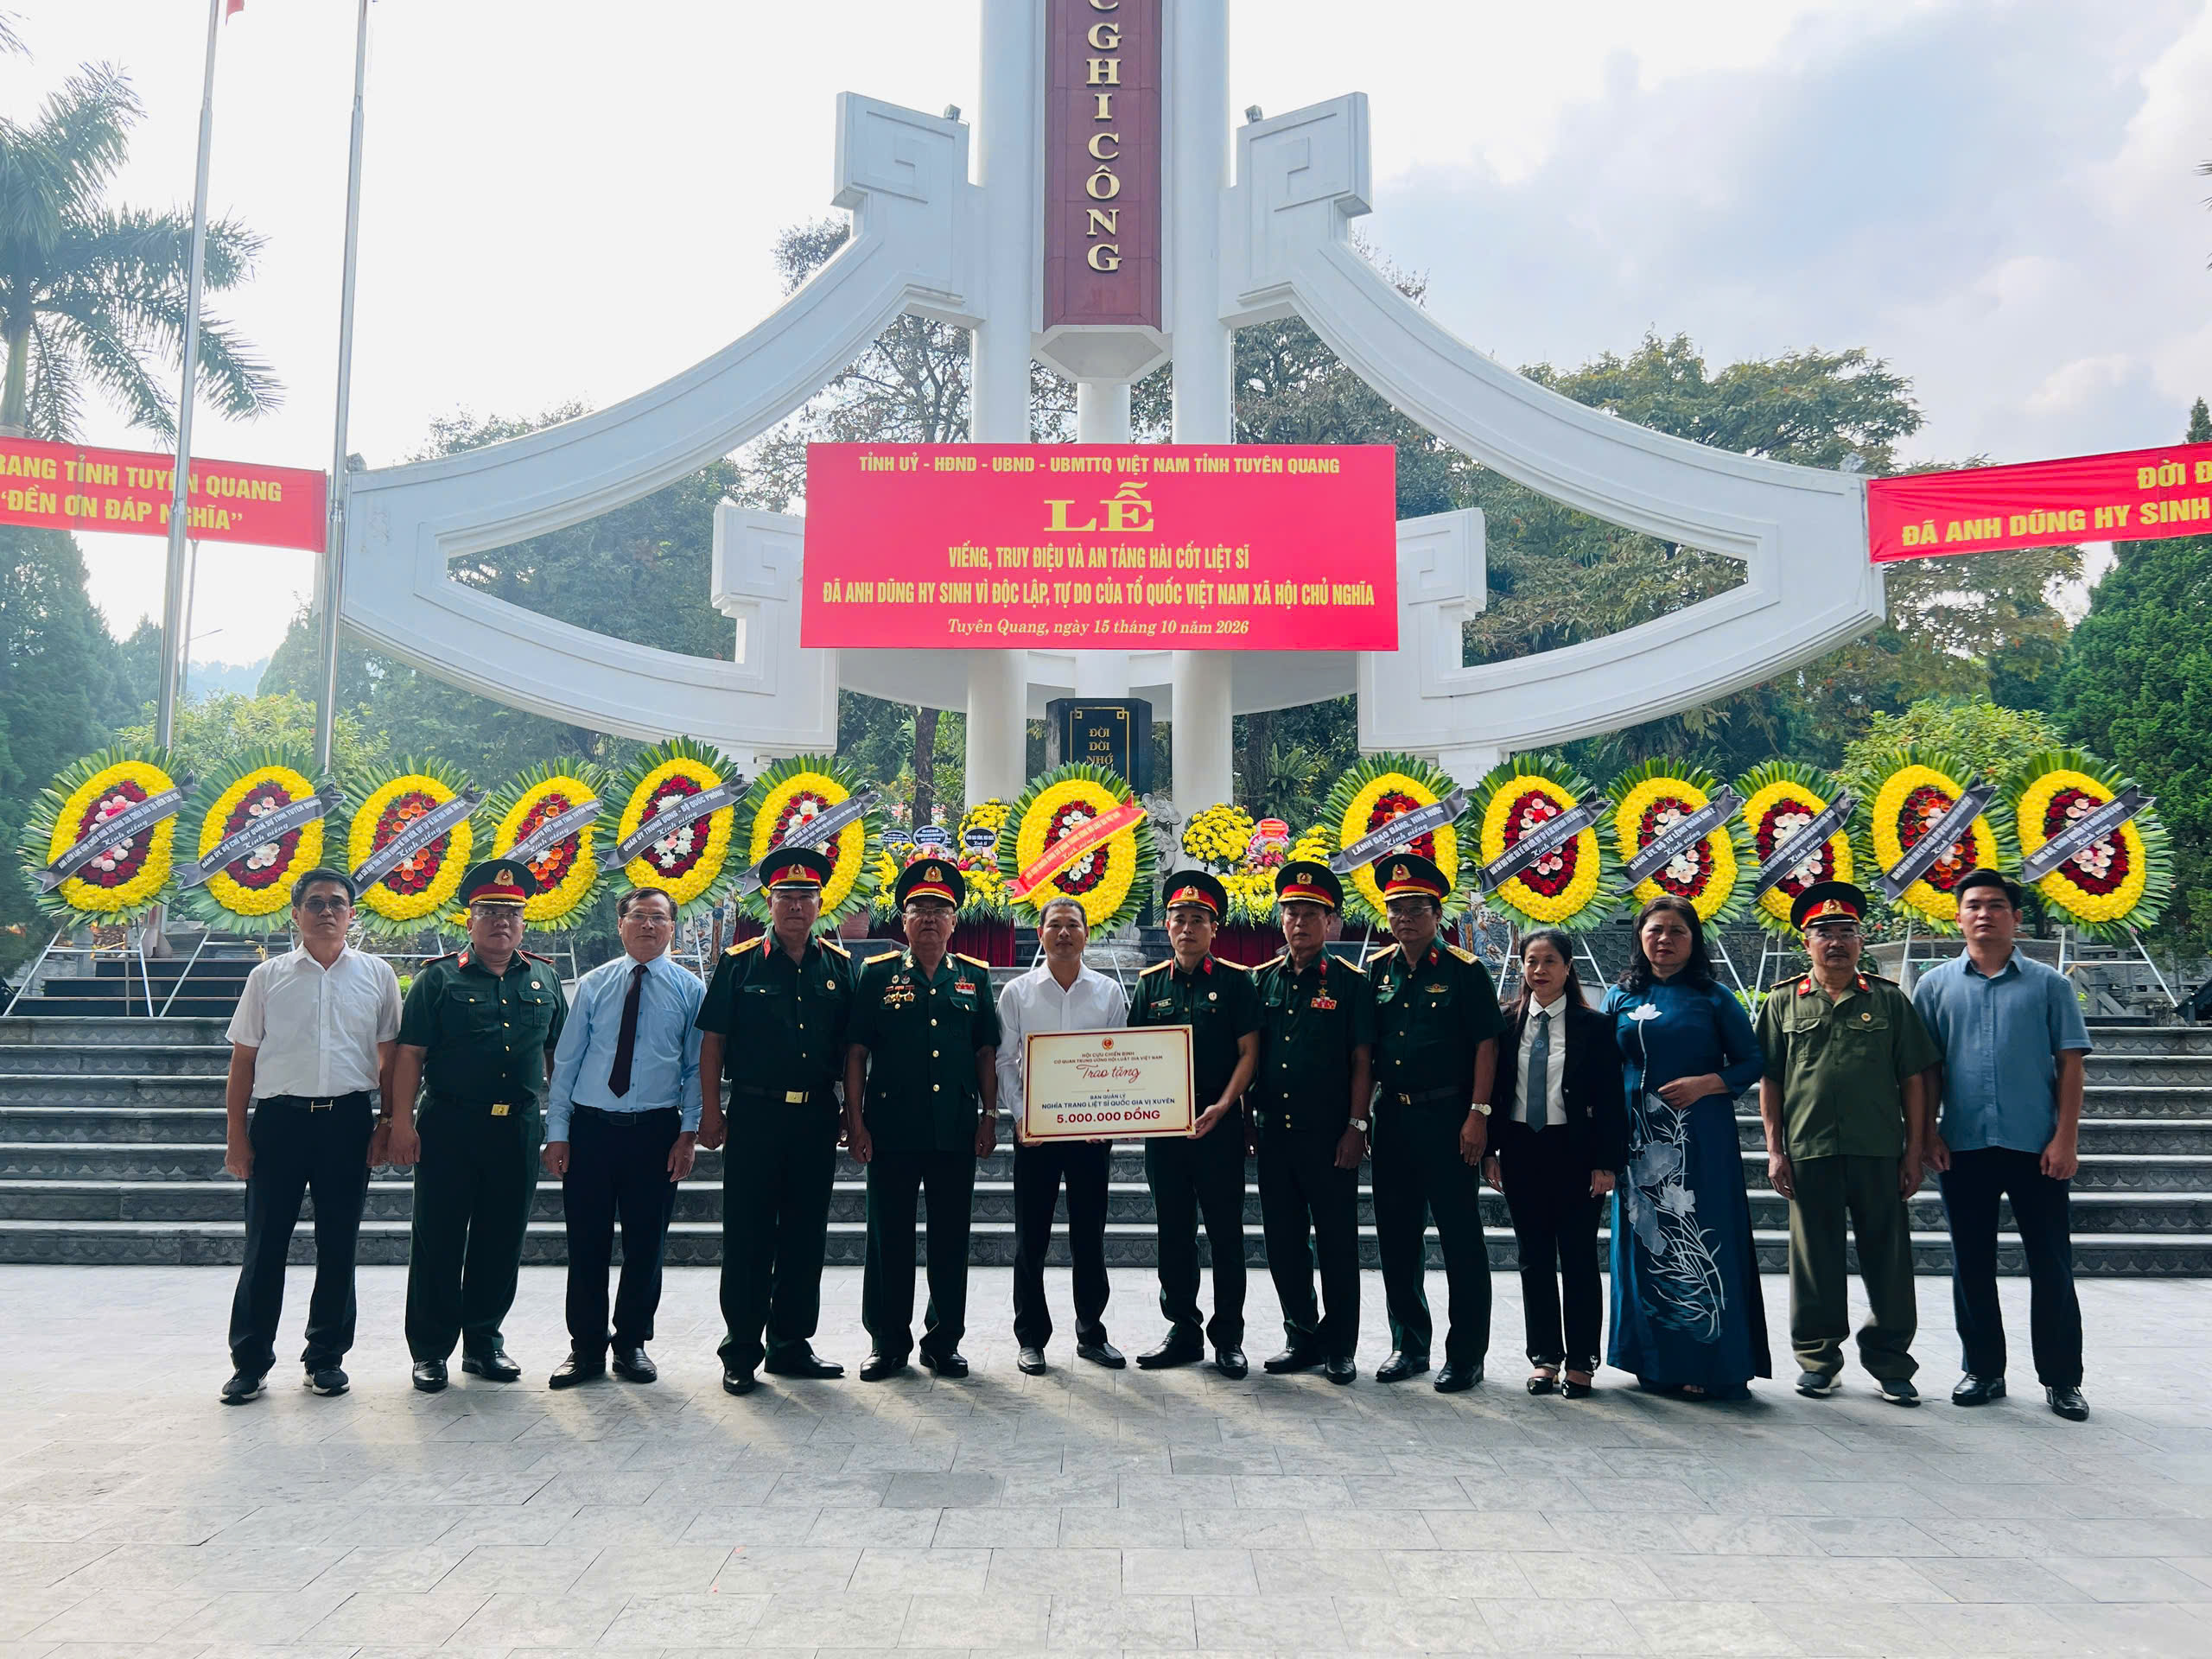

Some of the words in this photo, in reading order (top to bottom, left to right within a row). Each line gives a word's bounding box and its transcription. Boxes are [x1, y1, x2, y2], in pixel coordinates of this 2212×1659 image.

[1086, 22, 1122, 119] GHI
[1086, 132, 1122, 272] CÔNG
[64, 454, 118, 486] TỈNH
[206, 475, 283, 502] QUANG
[858, 451, 895, 472] TỈNH
[899, 451, 920, 472] UỶ
[934, 455, 977, 472] HĐND
[992, 456, 1035, 473] UBND
[1050, 456, 1113, 474] UBMTTQ
[1116, 454, 1150, 476] VIỆT
[1153, 456, 1190, 473] NAM
[1193, 452, 1230, 474] TỈNH
[1233, 454, 1283, 474] TUYÊN
[1287, 457, 1340, 475] QUANG
[2137, 459, 2186, 490] ĐỜI
[64, 494, 98, 518] ƠN
[105, 496, 153, 523] ĐÁP
[1043, 481, 1154, 532] LỄ
[1902, 519, 1938, 546] ĐÃ
[1945, 518, 2002, 543] ANH
[2009, 509, 2086, 537] DŨNG
[2094, 505, 2131, 530] HY
[2139, 497, 2211, 525] SINH
[948, 539, 993, 571] VIẾNG,
[995, 546, 1030, 569] TRUY
[1032, 542, 1064, 573] ĐIỆU
[1066, 542, 1085, 569] VÀ
[1087, 546, 1108, 569] AN
[1109, 543, 1147, 569] TÁNG
[1148, 543, 1173, 569] HÀI
[1175, 540, 1202, 569] CỐT
[1204, 543, 1233, 574] LIỆT
[1235, 543, 1250, 569] SĨ
[822, 577, 842, 603] ĐÃ
[844, 581, 874, 603] ANH
[877, 577, 915, 604] DŨNG
[918, 582, 937, 604] HY
[938, 582, 972, 604] SINH
[975, 577, 988, 604] VÌ
[991, 577, 1020, 609] ĐỘC
[1022, 578, 1051, 609] LẬP,
[1052, 580, 1072, 609] TỰ
[1073, 582, 1092, 605] DO
[1095, 575, 1123, 605] CỦA
[1125, 574, 1144, 605] TỔ
[1146, 575, 1183, 607] QUỐC
[1185, 578, 1215, 609] VIỆT
[1217, 583, 1249, 605] NAM
[1252, 579, 1272, 606] XÃ
[1274, 579, 1298, 610] HỘI
[1300, 576, 1329, 606] CHỦ
[1332, 580, 1376, 606] NGHĨA
[948, 618, 993, 637] Tuyên
[996, 618, 1050, 637] Quang,
[1052, 619, 1090, 637] ngày
[1093, 619, 1110, 634] 15
[1113, 619, 1158, 637] tháng
[1160, 620, 1178, 634] 10
[1179, 620, 1212, 634] năm
[1214, 620, 1249, 634] 2026
[643, 818, 662, 834] TRUNG
[680, 802, 690, 811] BỘ
[689, 795, 705, 808] QUỐC
[1388, 820, 1412, 834] ĐẢNG,
[1409, 812, 1427, 823] NHÀ
[228, 836, 240, 847] CHỈ
[238, 831, 251, 842] HUY
[250, 822, 266, 835] QUÂN
[1076, 1064, 1109, 1079] Trao
[1111, 1065, 1141, 1084] tặng
[1057, 1111, 1122, 1123] 5.000.000
[1088, 1100, 1102, 1109] LIỆT
